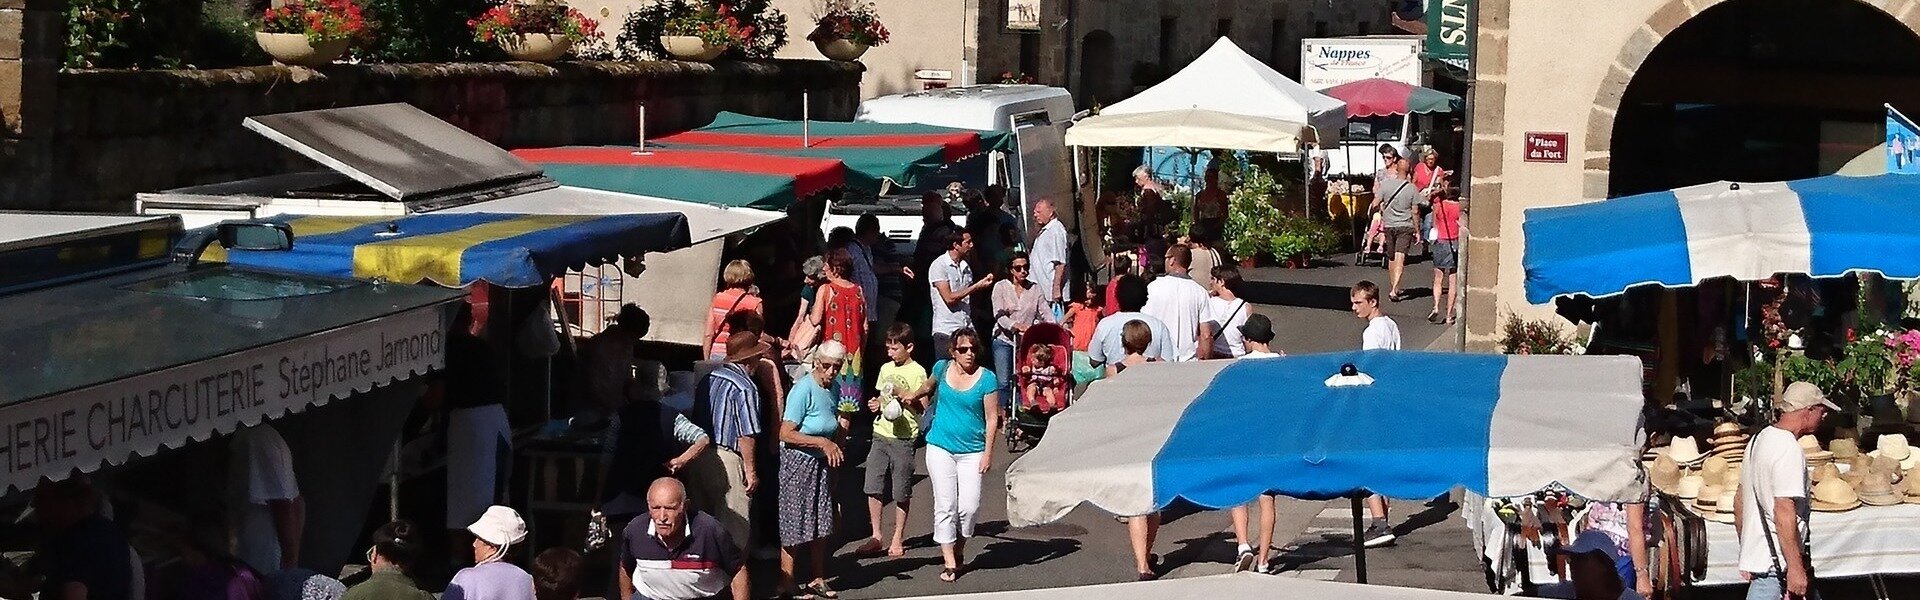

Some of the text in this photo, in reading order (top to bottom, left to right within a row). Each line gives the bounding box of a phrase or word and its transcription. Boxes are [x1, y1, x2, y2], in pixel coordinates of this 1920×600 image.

[1319, 46, 1371, 61] Nappes
[1535, 138, 1558, 148] Place
[1530, 149, 1562, 159] du Fort
[87, 363, 265, 450] CHARCUTERIE
[278, 344, 371, 399] Stéphane
[376, 314, 441, 371] Jamond
